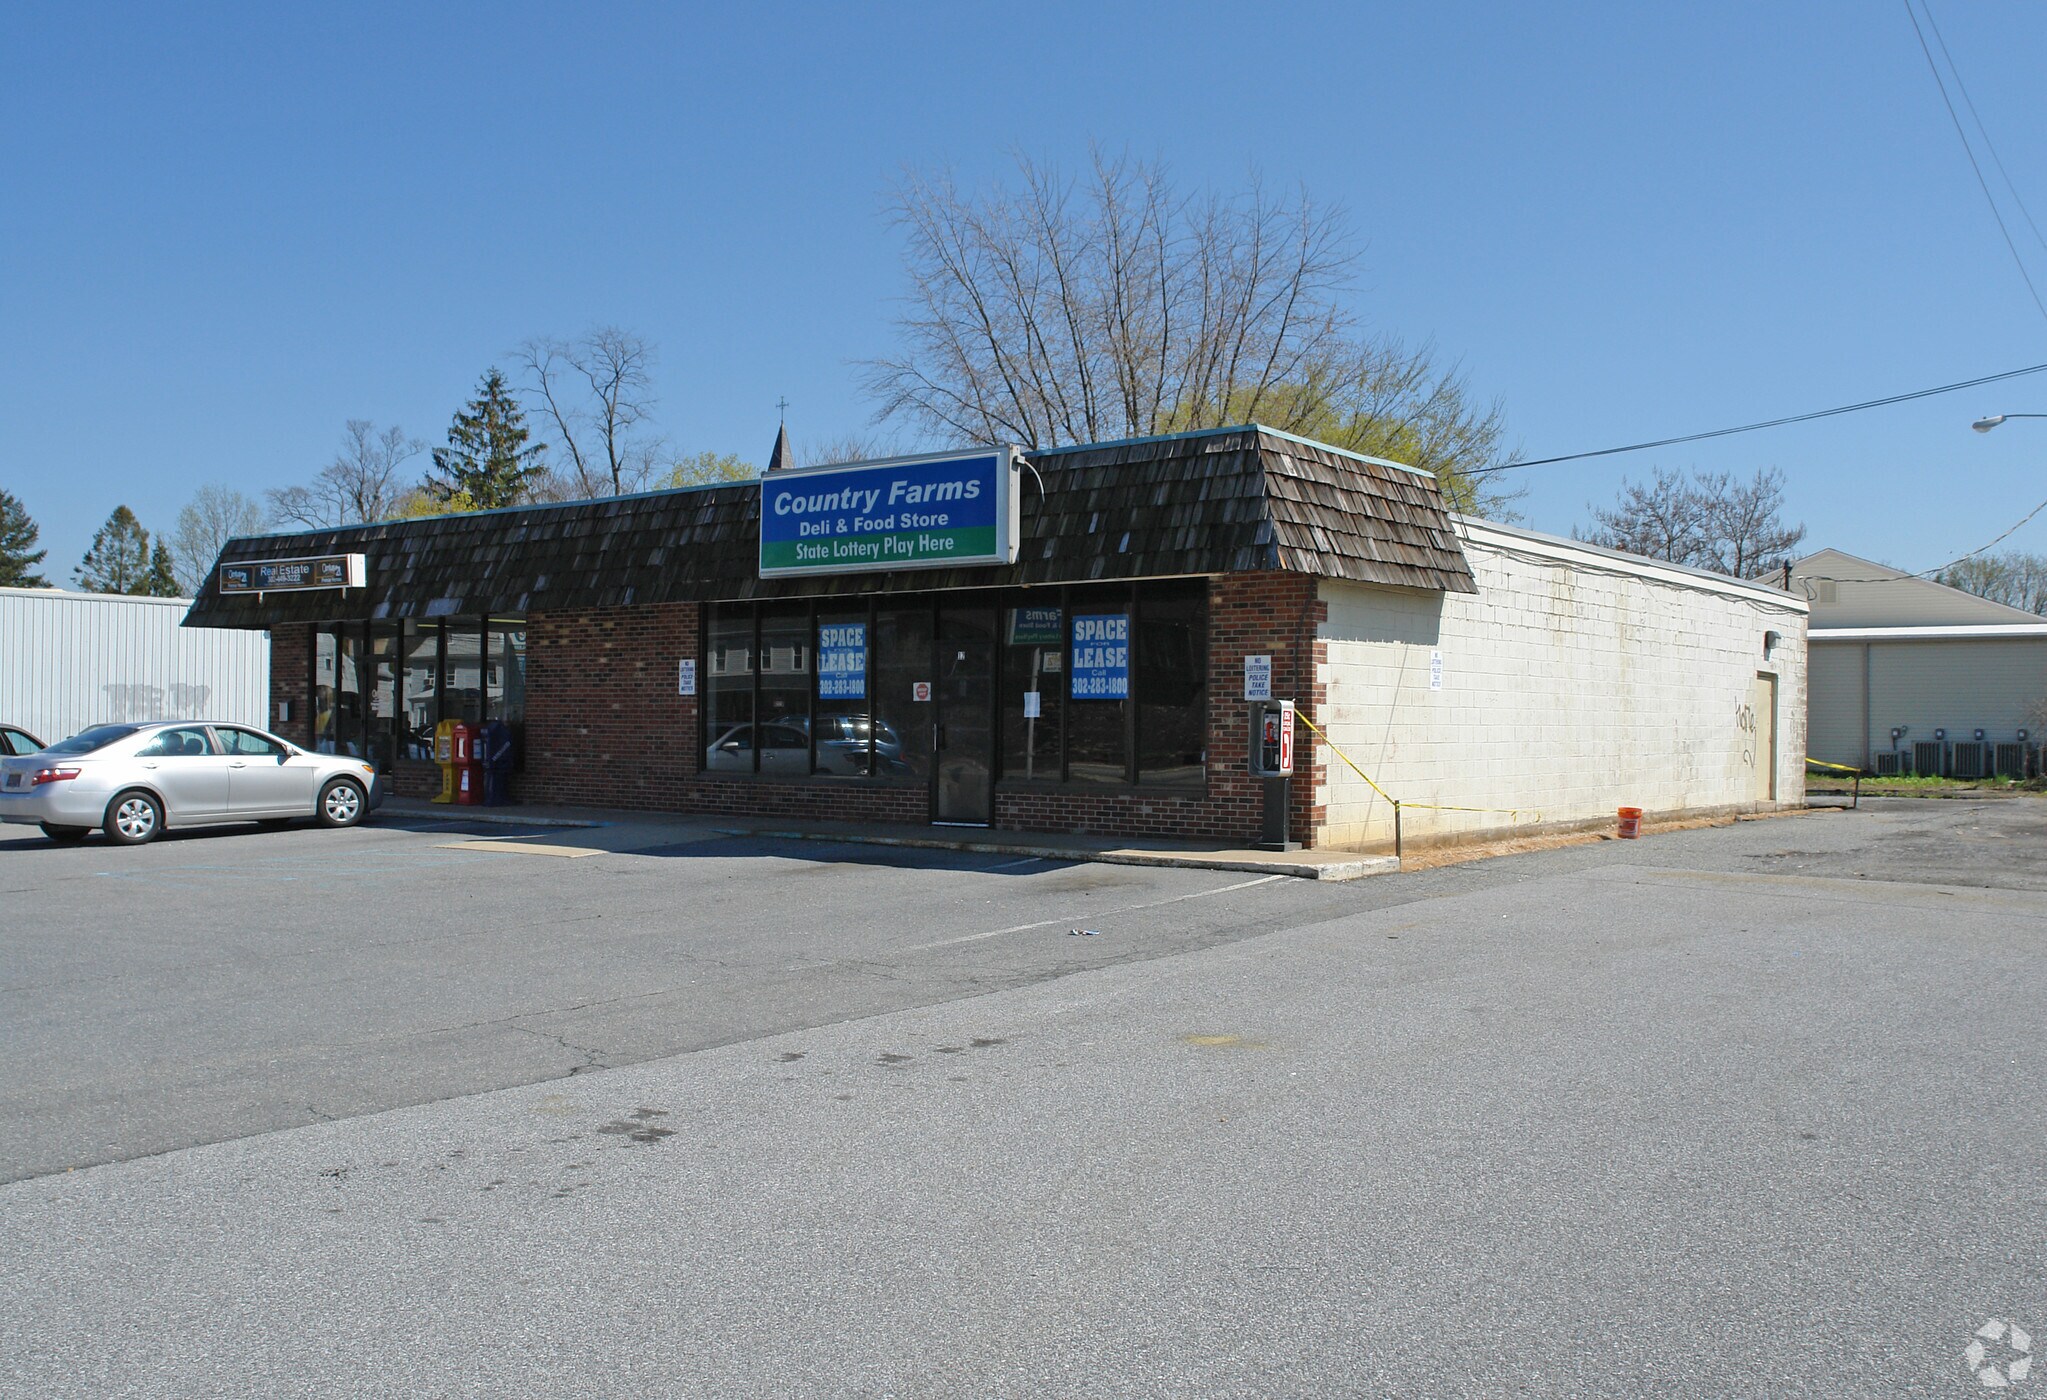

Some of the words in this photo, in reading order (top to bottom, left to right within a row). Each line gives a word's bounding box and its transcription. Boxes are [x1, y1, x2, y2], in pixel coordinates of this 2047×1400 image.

[774, 485, 880, 516] Country
[888, 479, 981, 506] Farms
[800, 520, 830, 537] Deli
[836, 518, 848, 534] &
[854, 515, 895, 532] Food
[900, 513, 949, 529] Store
[796, 542, 829, 560] State
[833, 540, 880, 560] Lottery
[884, 536, 914, 557] Play
[919, 534, 954, 552] Here
[260, 566, 279, 577] Real
[279, 564, 310, 575] Estate
[821, 628, 864, 648] SPACE
[1075, 619, 1127, 641] SPACE
[821, 652, 864, 672] LEASE
[1074, 647, 1127, 668] LEASE
[820, 679, 865, 695] 302-283-1800
[1072, 677, 1128, 694] 302-283-1800
